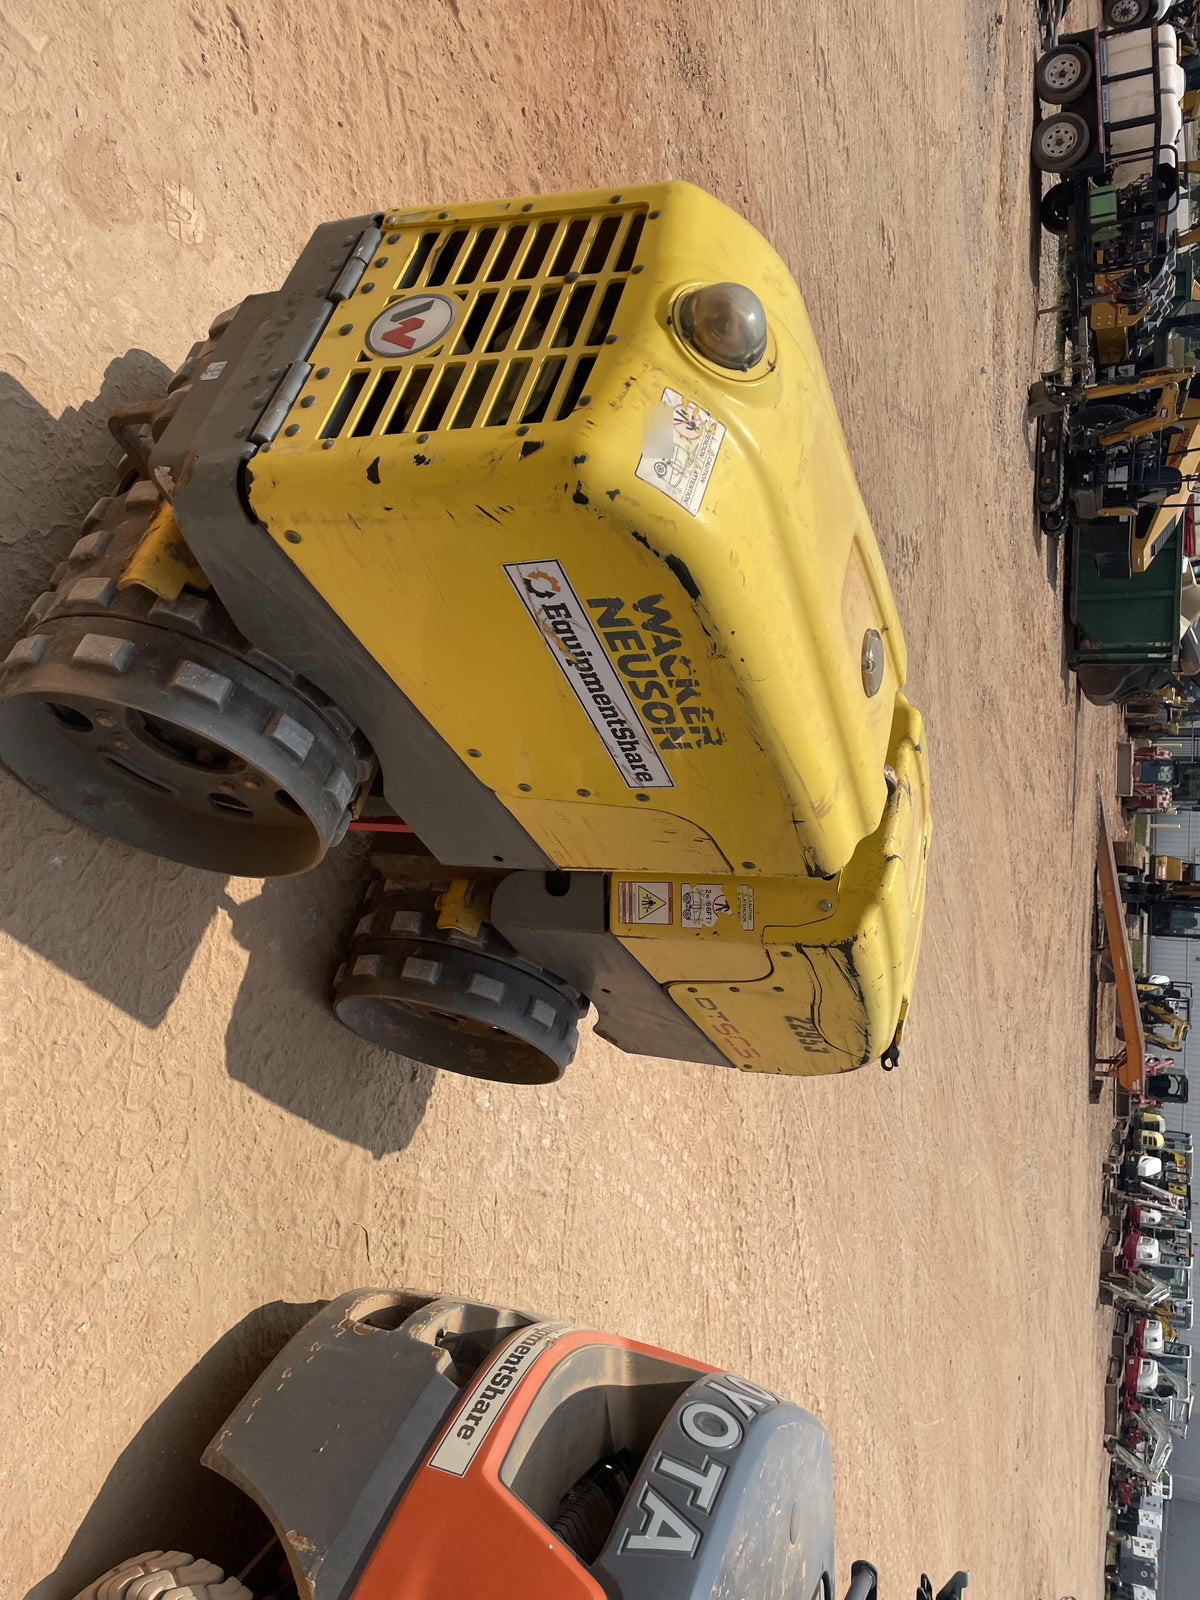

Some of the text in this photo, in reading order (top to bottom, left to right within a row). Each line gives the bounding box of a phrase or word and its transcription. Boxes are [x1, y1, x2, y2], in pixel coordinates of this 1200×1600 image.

[683, 470, 699, 506] ATTENTION
[699, 456, 713, 485] CAUTION
[540, 603, 655, 782] EquipmentShare
[586, 597, 693, 750] NEUSON
